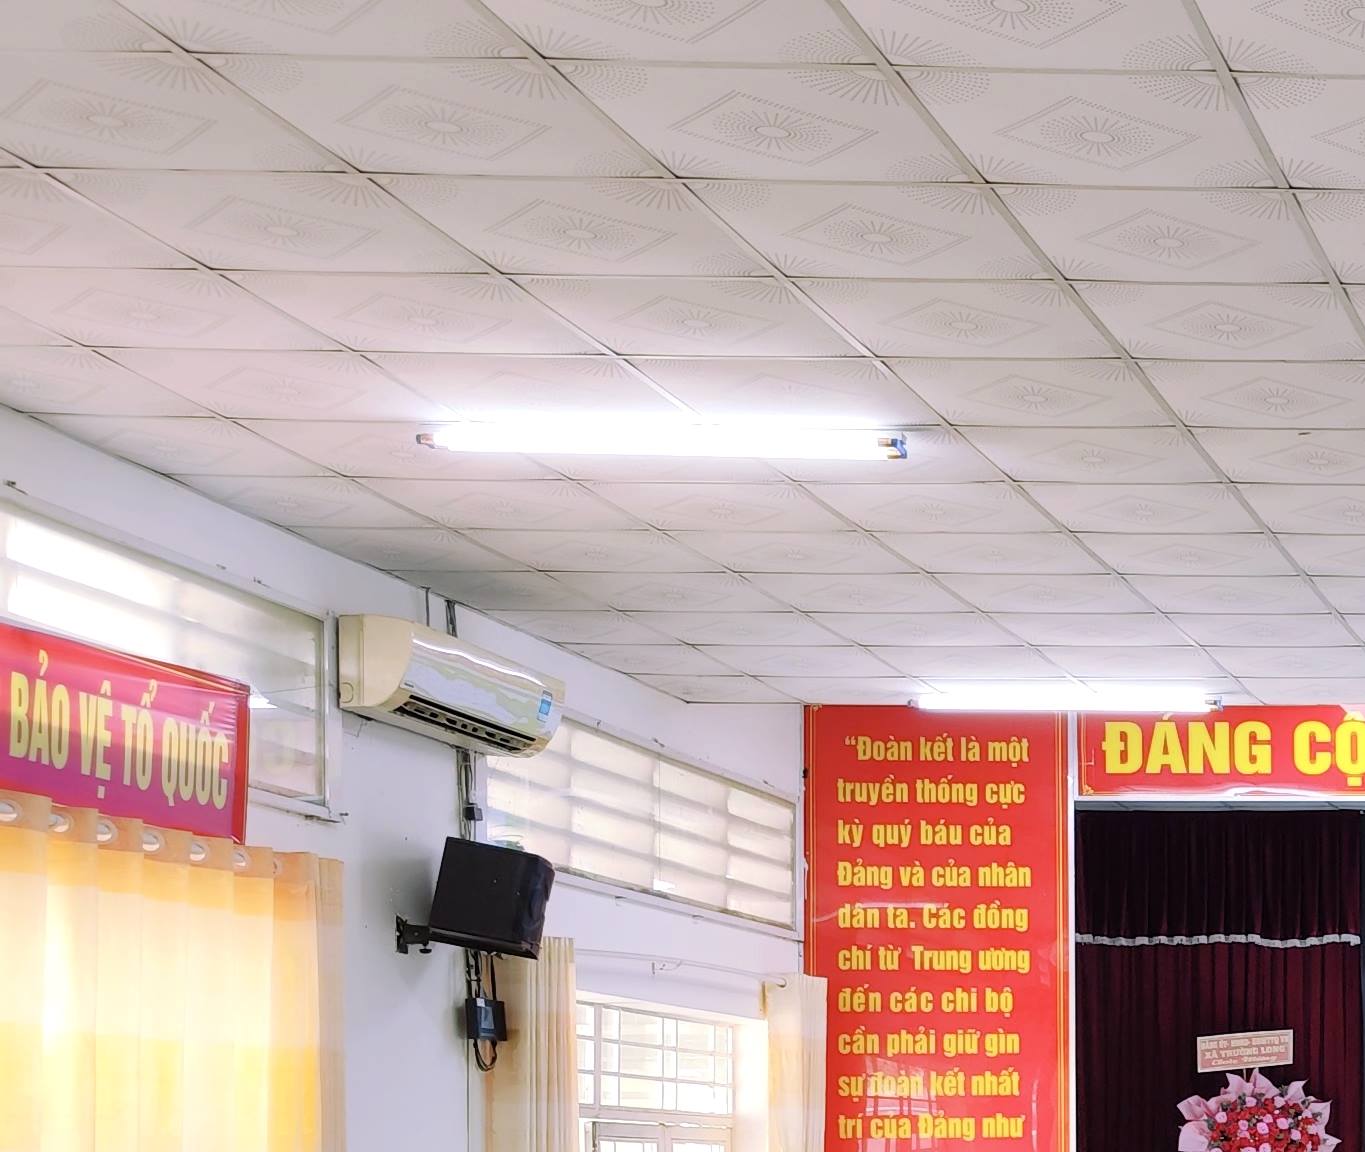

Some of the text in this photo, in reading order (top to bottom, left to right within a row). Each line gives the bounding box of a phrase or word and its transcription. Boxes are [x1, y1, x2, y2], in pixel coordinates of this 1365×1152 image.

[9, 649, 229, 810] BẢO VỆ TỔ QUỐC
[919, 734, 954, 762] kết
[961, 736, 980, 762] là
[988, 737, 1029, 767] một
[837, 775, 1026, 808] truyền thống cực
[837, 818, 1012, 847] kỳ quý báu của
[837, 858, 1031, 889] Đảng và của nhân
